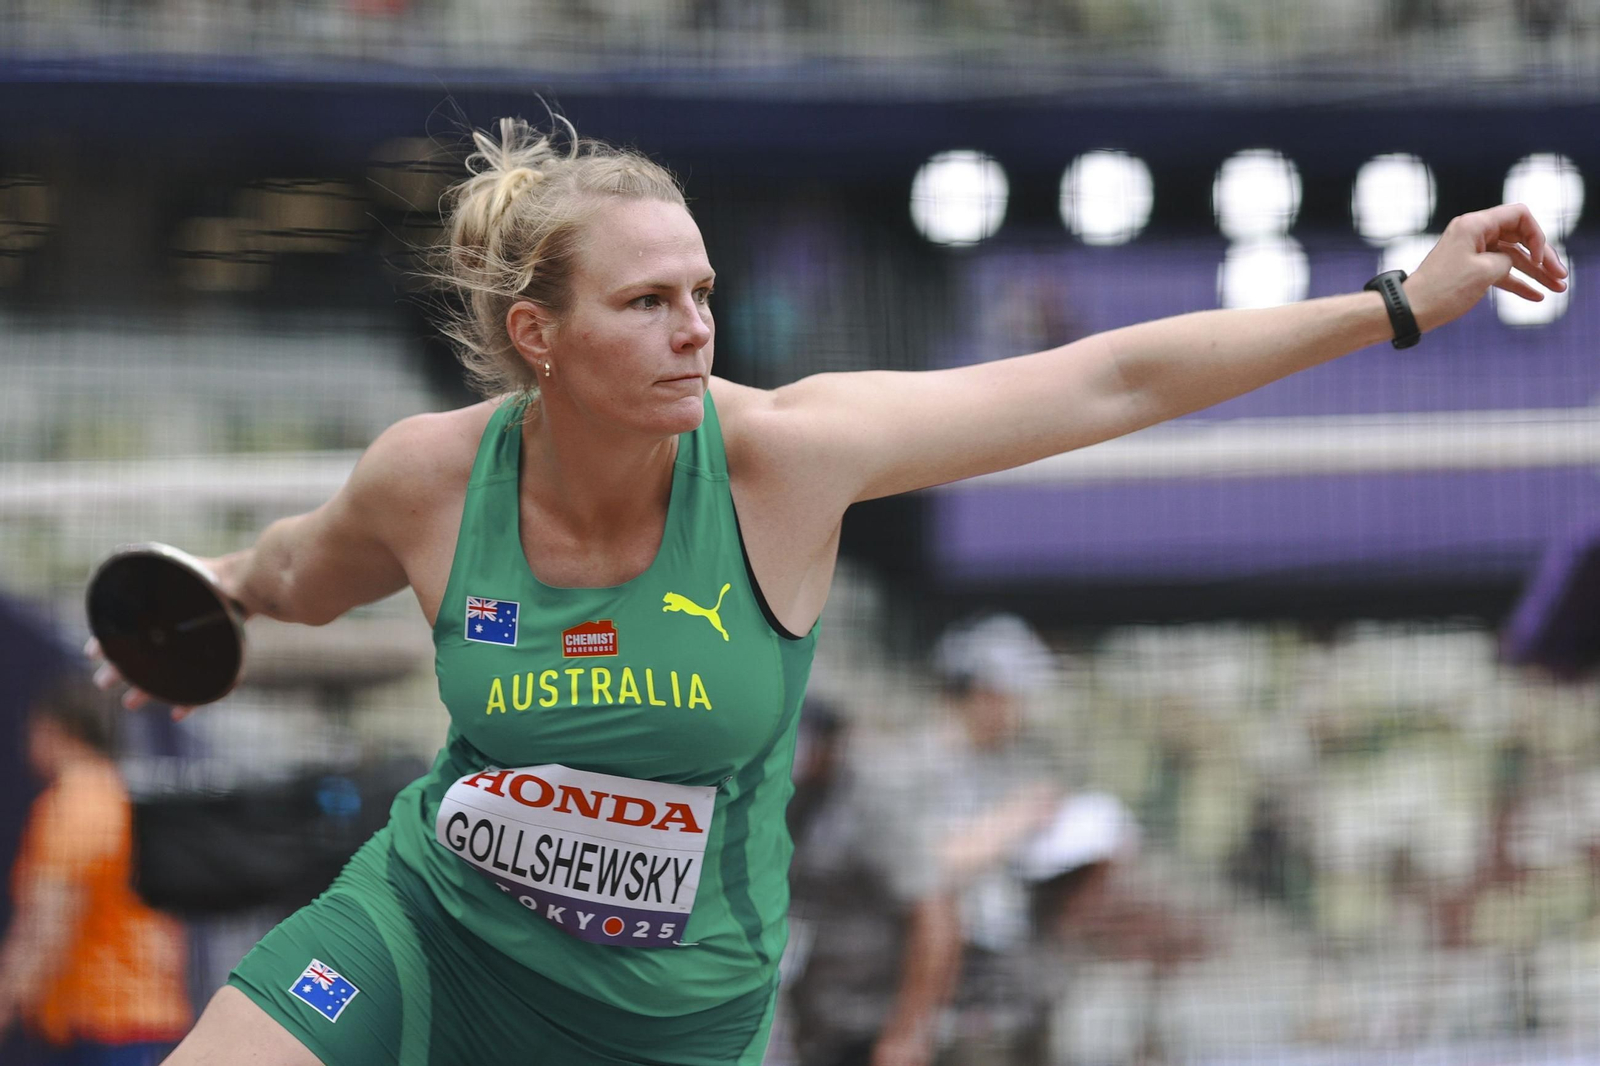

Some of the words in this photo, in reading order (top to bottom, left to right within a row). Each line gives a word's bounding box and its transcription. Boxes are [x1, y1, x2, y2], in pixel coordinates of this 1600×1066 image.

[565, 632, 615, 646] CHEMIST
[566, 645, 614, 653] WAREHOUSE
[486, 667, 712, 715] AUSTRALIA
[462, 770, 703, 833] HONDA
[446, 811, 693, 904] GOLLSHEWSKY
[632, 920, 676, 939] 25
